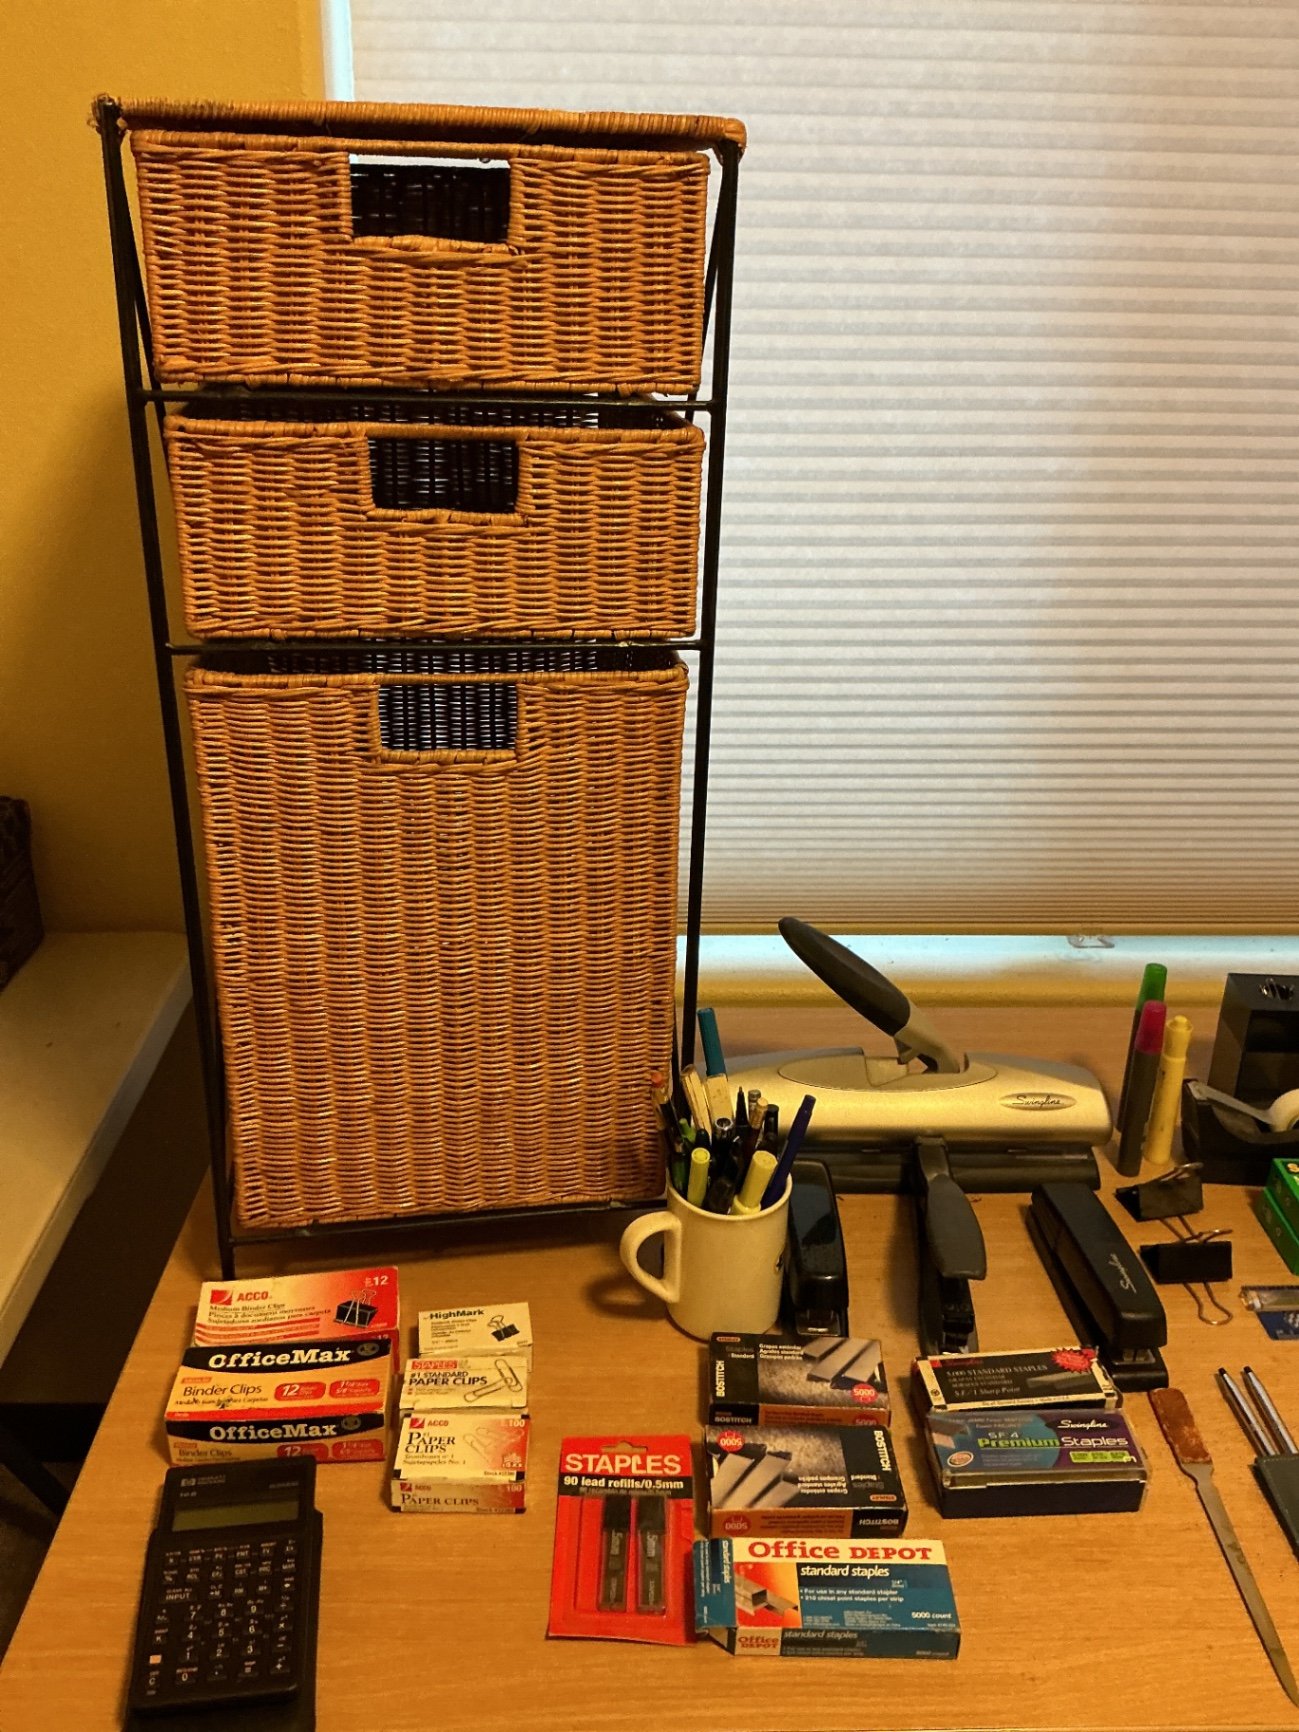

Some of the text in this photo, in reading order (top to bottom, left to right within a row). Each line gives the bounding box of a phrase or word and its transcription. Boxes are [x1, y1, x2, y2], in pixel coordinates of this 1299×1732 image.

[373, 1275, 389, 1286] 12
[237, 1291, 269, 1302] ACCO
[267, 1302, 286, 1310] Clips
[430, 1309, 484, 1320] HighMark
[208, 1348, 351, 1369] OfficeMax
[967, 1367, 1012, 1376] STANDARD
[1013, 1364, 1048, 1373] STAPLES
[409, 1376, 488, 1386] PAPER CLIPS
[715, 1360, 725, 1397] BOSTITCH
[183, 1383, 262, 1397] Binder Clips
[281, 1384, 299, 1396] 12
[509, 1419, 525, 1427] 100
[1057, 1419, 1109, 1430] Swingline
[209, 1423, 337, 1441] OfficeMax
[407, 1432, 456, 1445] PAPER
[719, 1438, 743, 1446] 5000
[977, 1436, 1129, 1448] Premium Staples
[209, 1448, 233, 1456] Clips
[405, 1444, 447, 1454] CLIPS
[873, 1430, 892, 1472] BOSTITCH
[565, 1454, 681, 1475] STAPLES
[564, 1476, 684, 1489] 90 lead refills/0.5mm
[401, 1493, 440, 1505] PAPER
[748, 1541, 932, 1560] Office DEPOT
[800, 1565, 890, 1579] standard staples
[165, 1592, 190, 1601] INPUT
[738, 1636, 778, 1644] Office
[784, 1630, 858, 1640] standard staples
